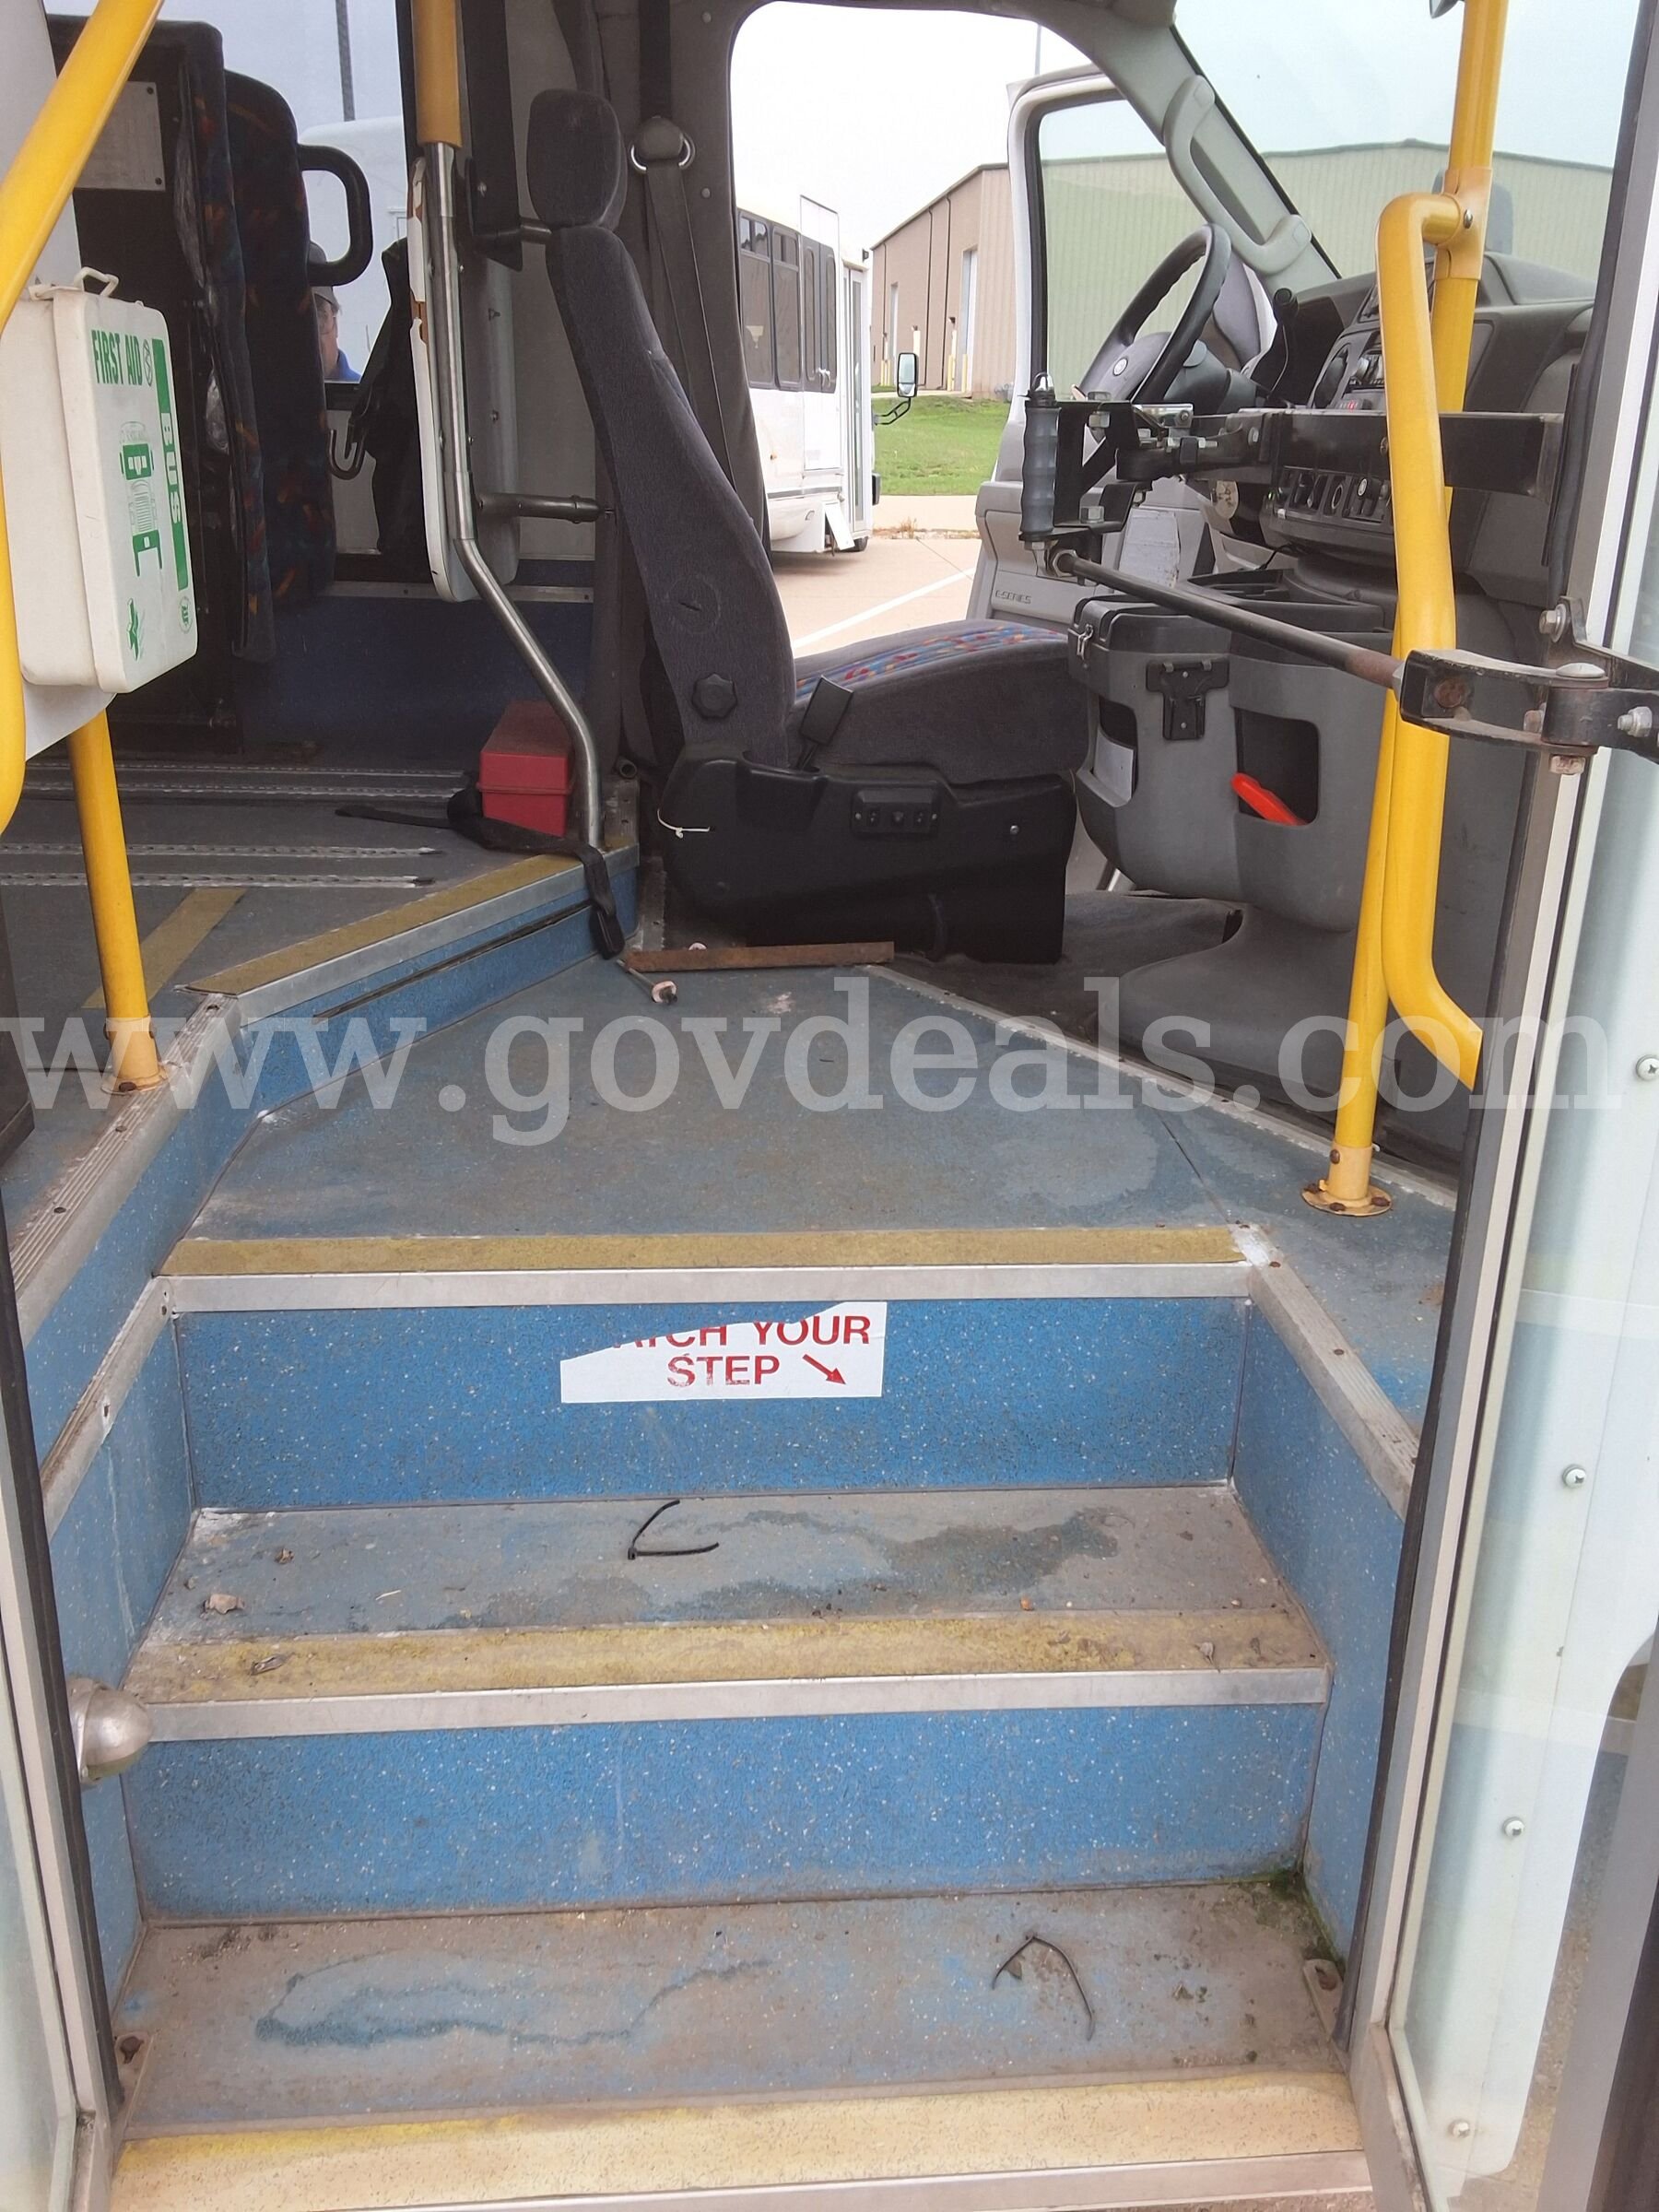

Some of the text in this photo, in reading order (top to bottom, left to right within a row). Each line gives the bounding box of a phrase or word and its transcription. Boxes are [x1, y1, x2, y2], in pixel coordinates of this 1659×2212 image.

[91, 329, 143, 385] FIRST AID
[160, 412, 181, 524] BUS
[753, 1315, 871, 1346] YOUR
[666, 1355, 780, 1386] STEP
